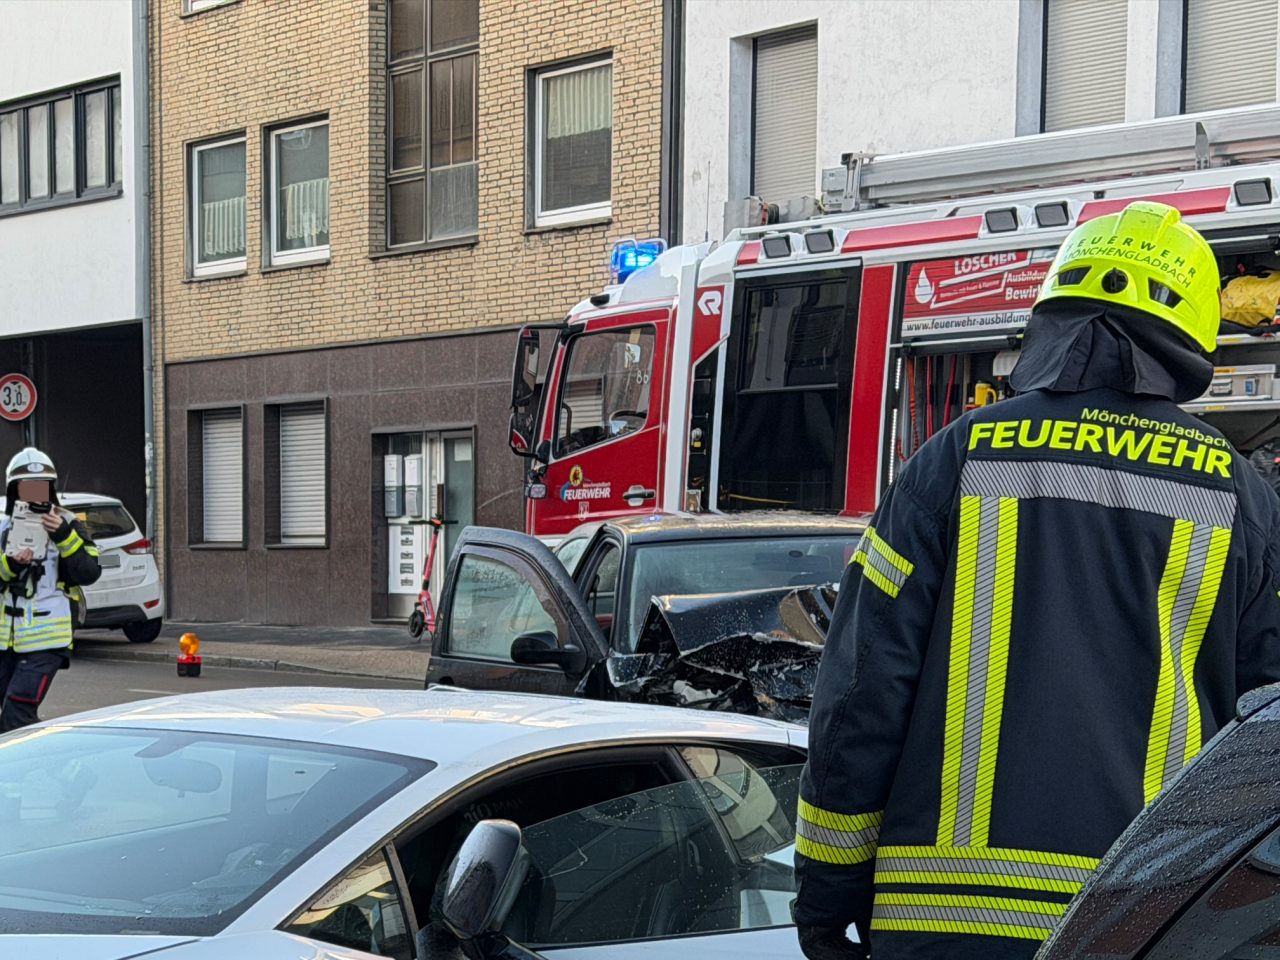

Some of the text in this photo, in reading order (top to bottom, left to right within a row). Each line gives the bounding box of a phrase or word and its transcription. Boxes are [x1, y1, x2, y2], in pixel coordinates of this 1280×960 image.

[968, 419, 1232, 478] FEUERWEHR
[1080, 407, 1232, 449] Mönchengladbach
[563, 487, 611, 501] FEUERWEHR
